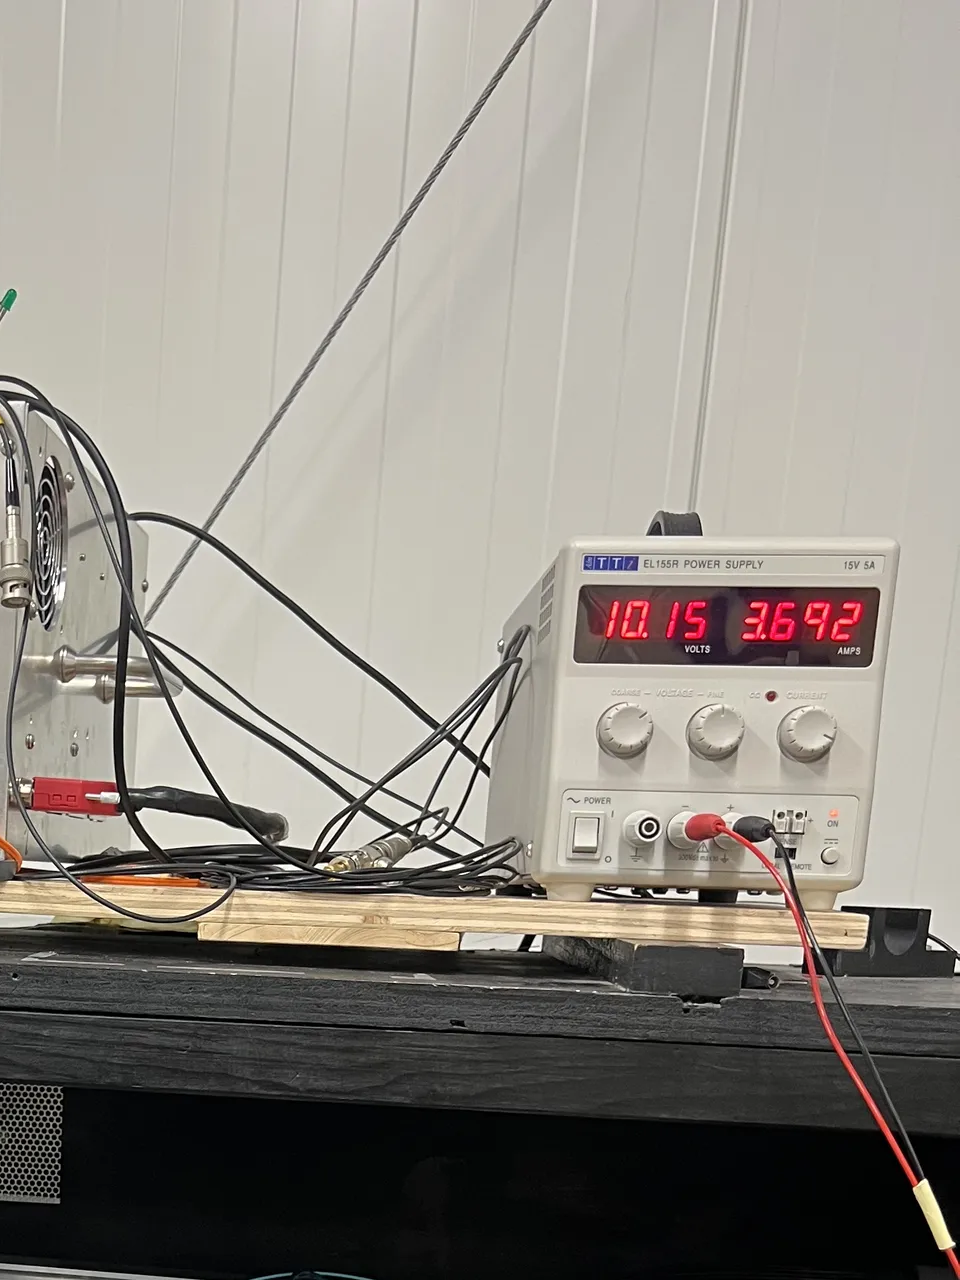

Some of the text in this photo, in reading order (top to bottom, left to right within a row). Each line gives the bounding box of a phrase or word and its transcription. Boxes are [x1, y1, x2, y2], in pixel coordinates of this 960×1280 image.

[643, 559, 764, 570] EL155R POWER SUPPLY
[844, 561, 875, 570] 15V 5A
[605, 600, 707, 640] 10.15
[741, 601, 863, 642] 3.692
[684, 645, 711, 654] VOLTS
[837, 647, 861, 656] AMPS
[655, 688, 694, 698] VOLTAGE
[583, 796, 612, 805] POWER
[827, 820, 839, 828] ON
